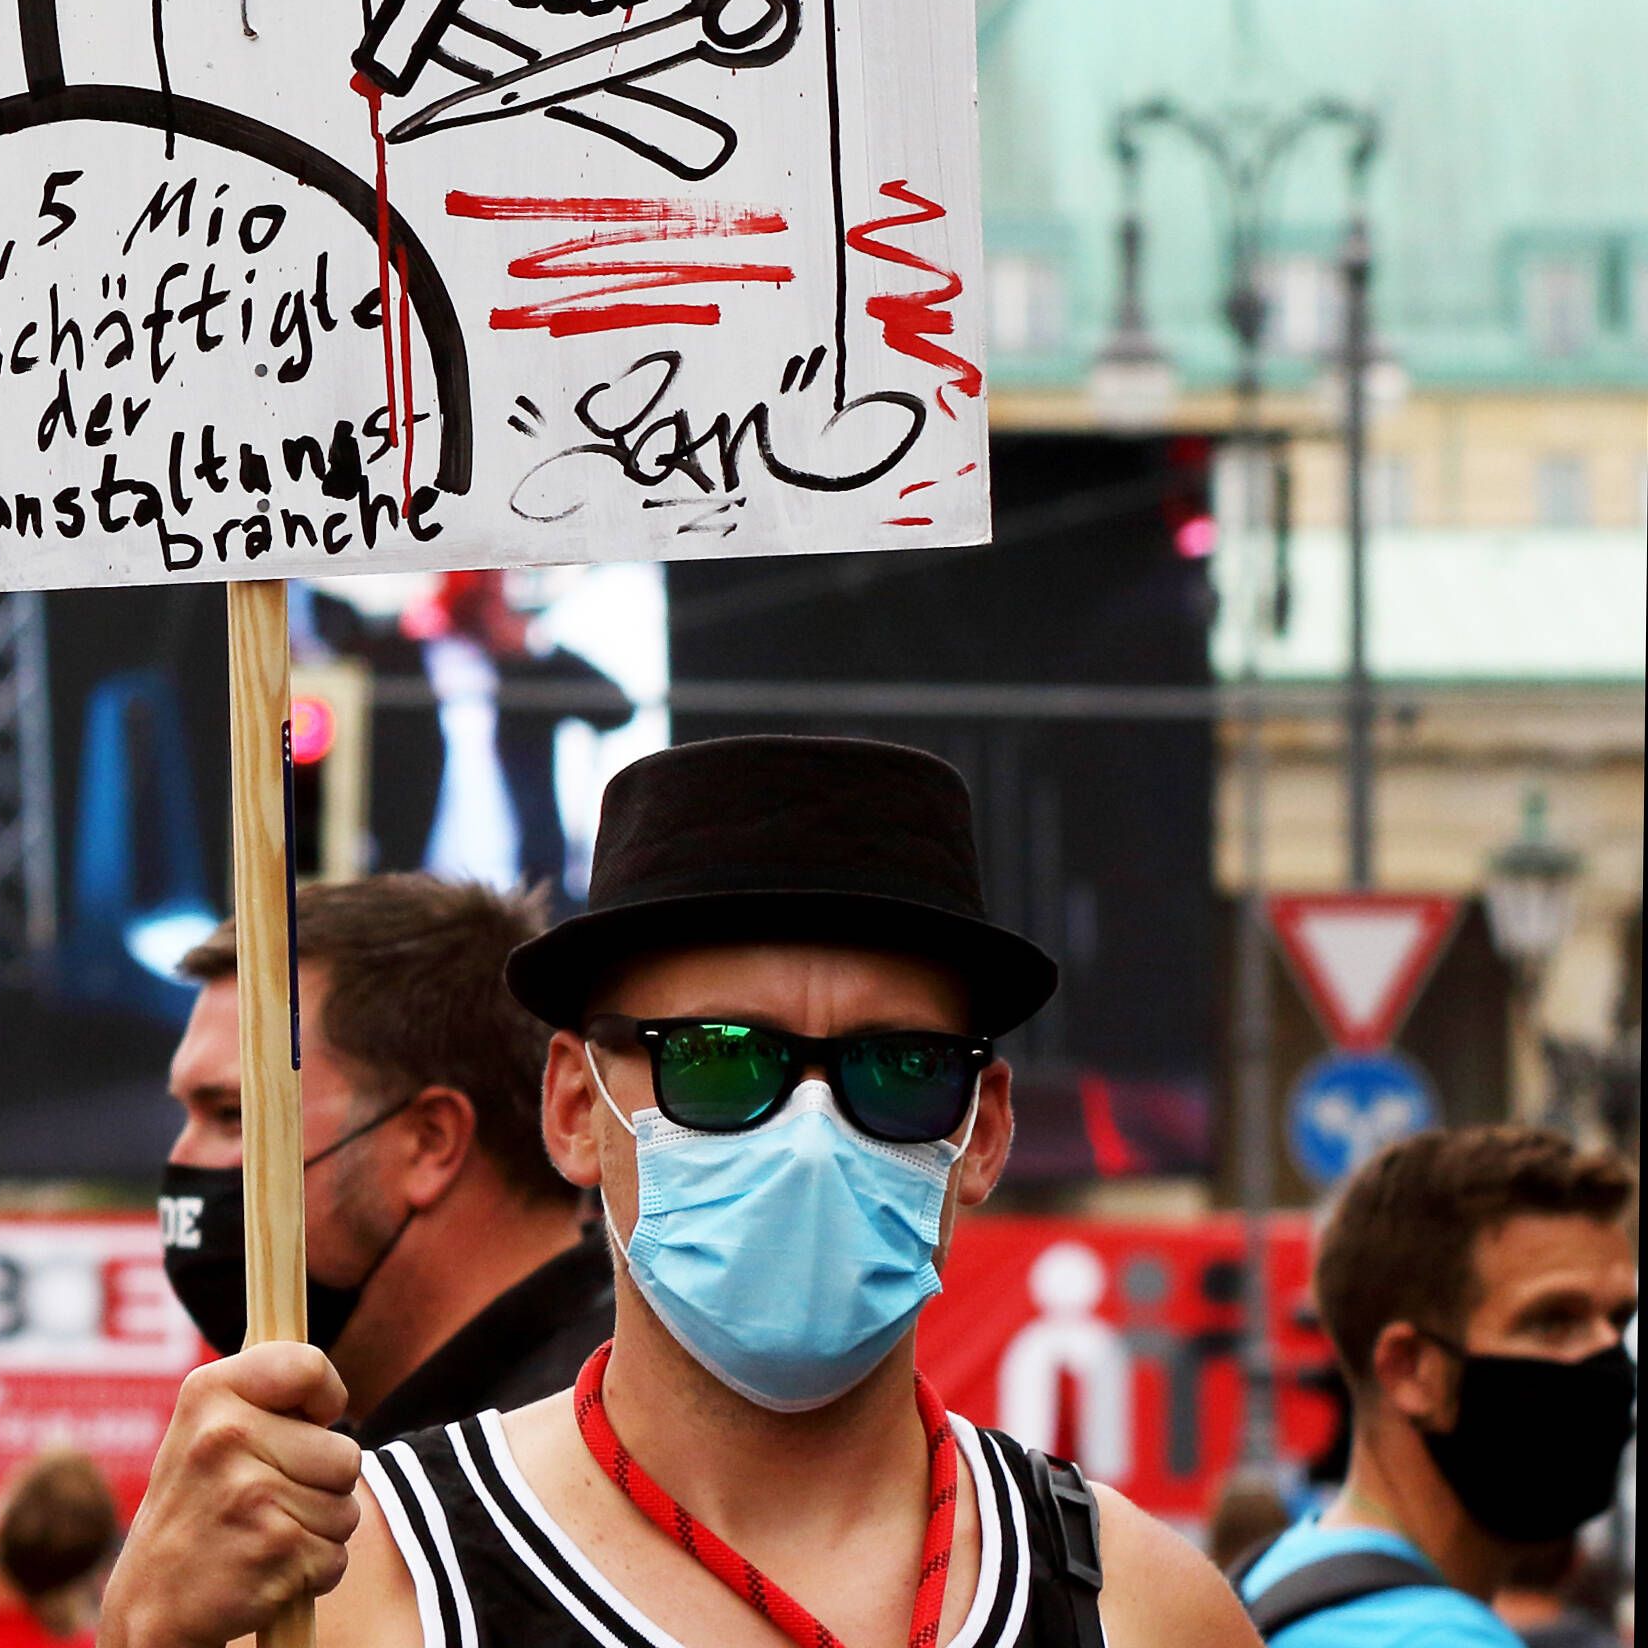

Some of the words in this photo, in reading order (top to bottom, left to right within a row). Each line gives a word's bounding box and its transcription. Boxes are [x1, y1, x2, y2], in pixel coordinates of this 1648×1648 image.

[122, 177, 287, 255] Mio
[37, 369, 151, 452] der
[160, 474, 445, 573] branche
